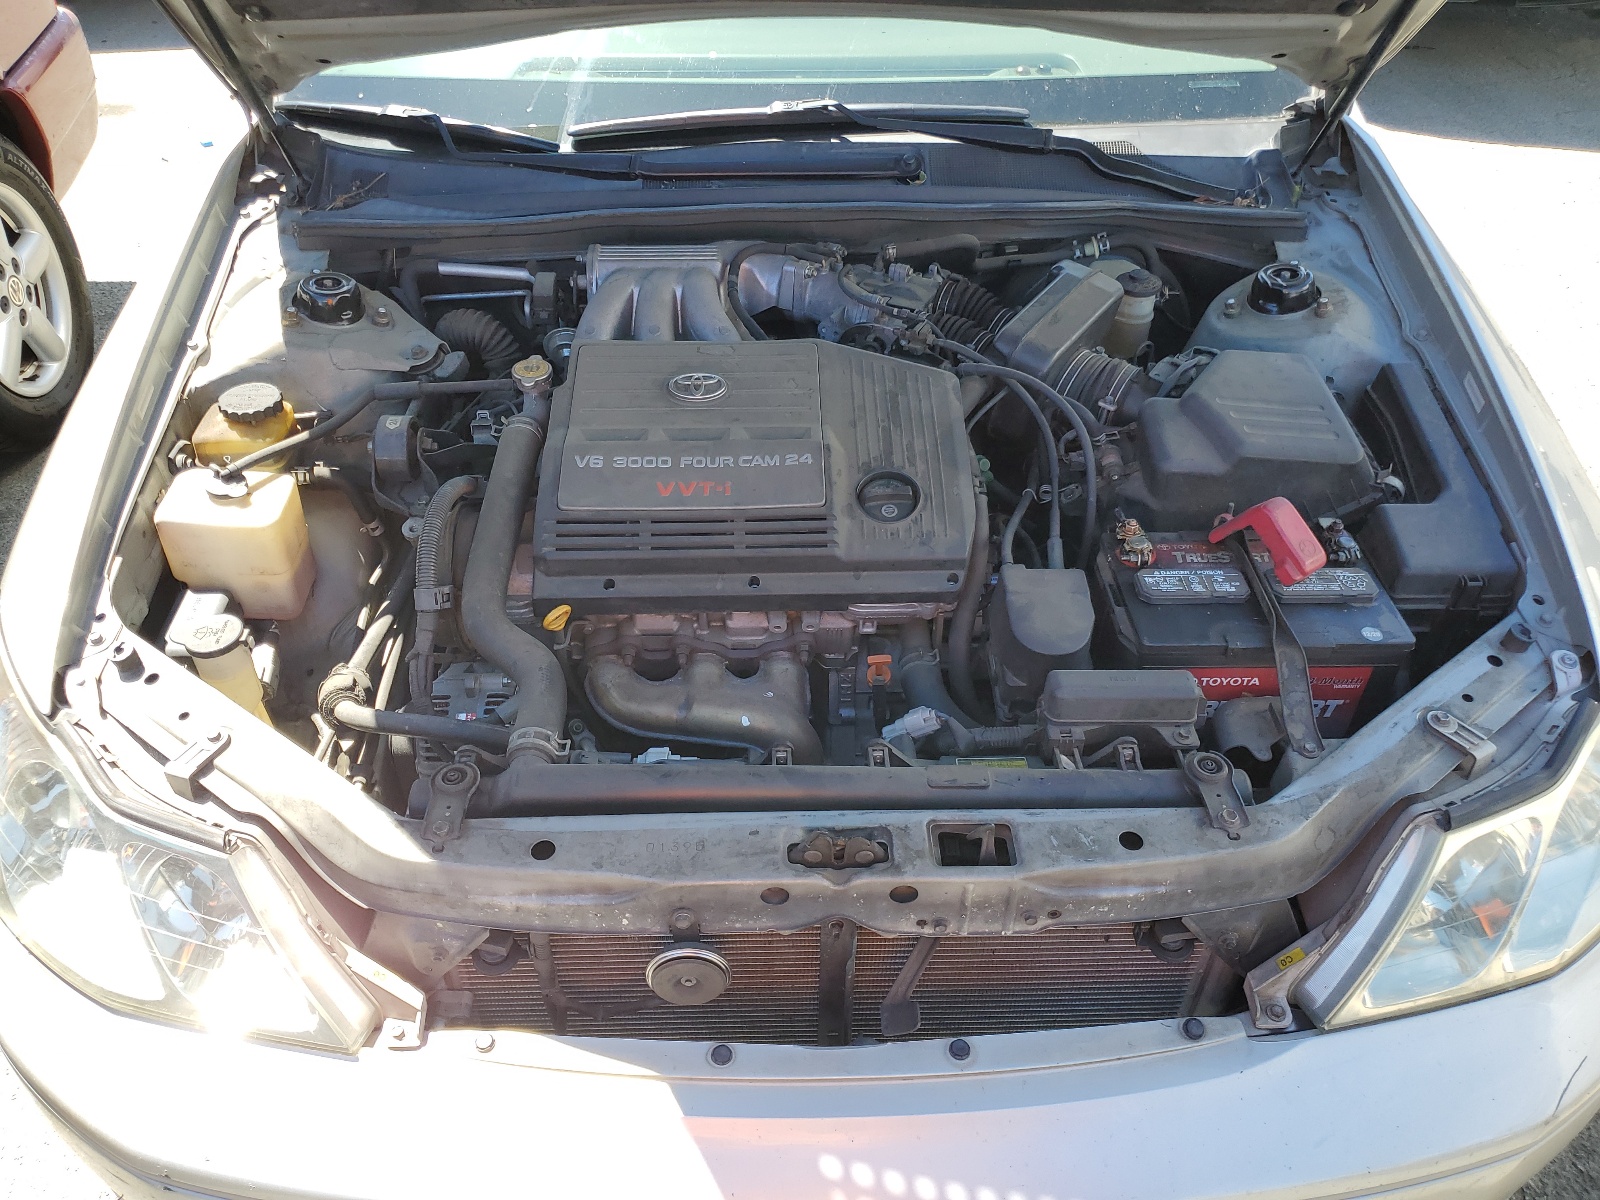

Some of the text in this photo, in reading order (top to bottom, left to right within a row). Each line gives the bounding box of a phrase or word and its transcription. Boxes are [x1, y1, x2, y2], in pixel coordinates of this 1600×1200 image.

[7, 153, 46, 191] ALTIMAX
[574, 453, 813, 468] V6 3000 FOUR CAM 24
[656, 481, 732, 497] VVT-i
[1201, 677, 1260, 686] TOYOTA
